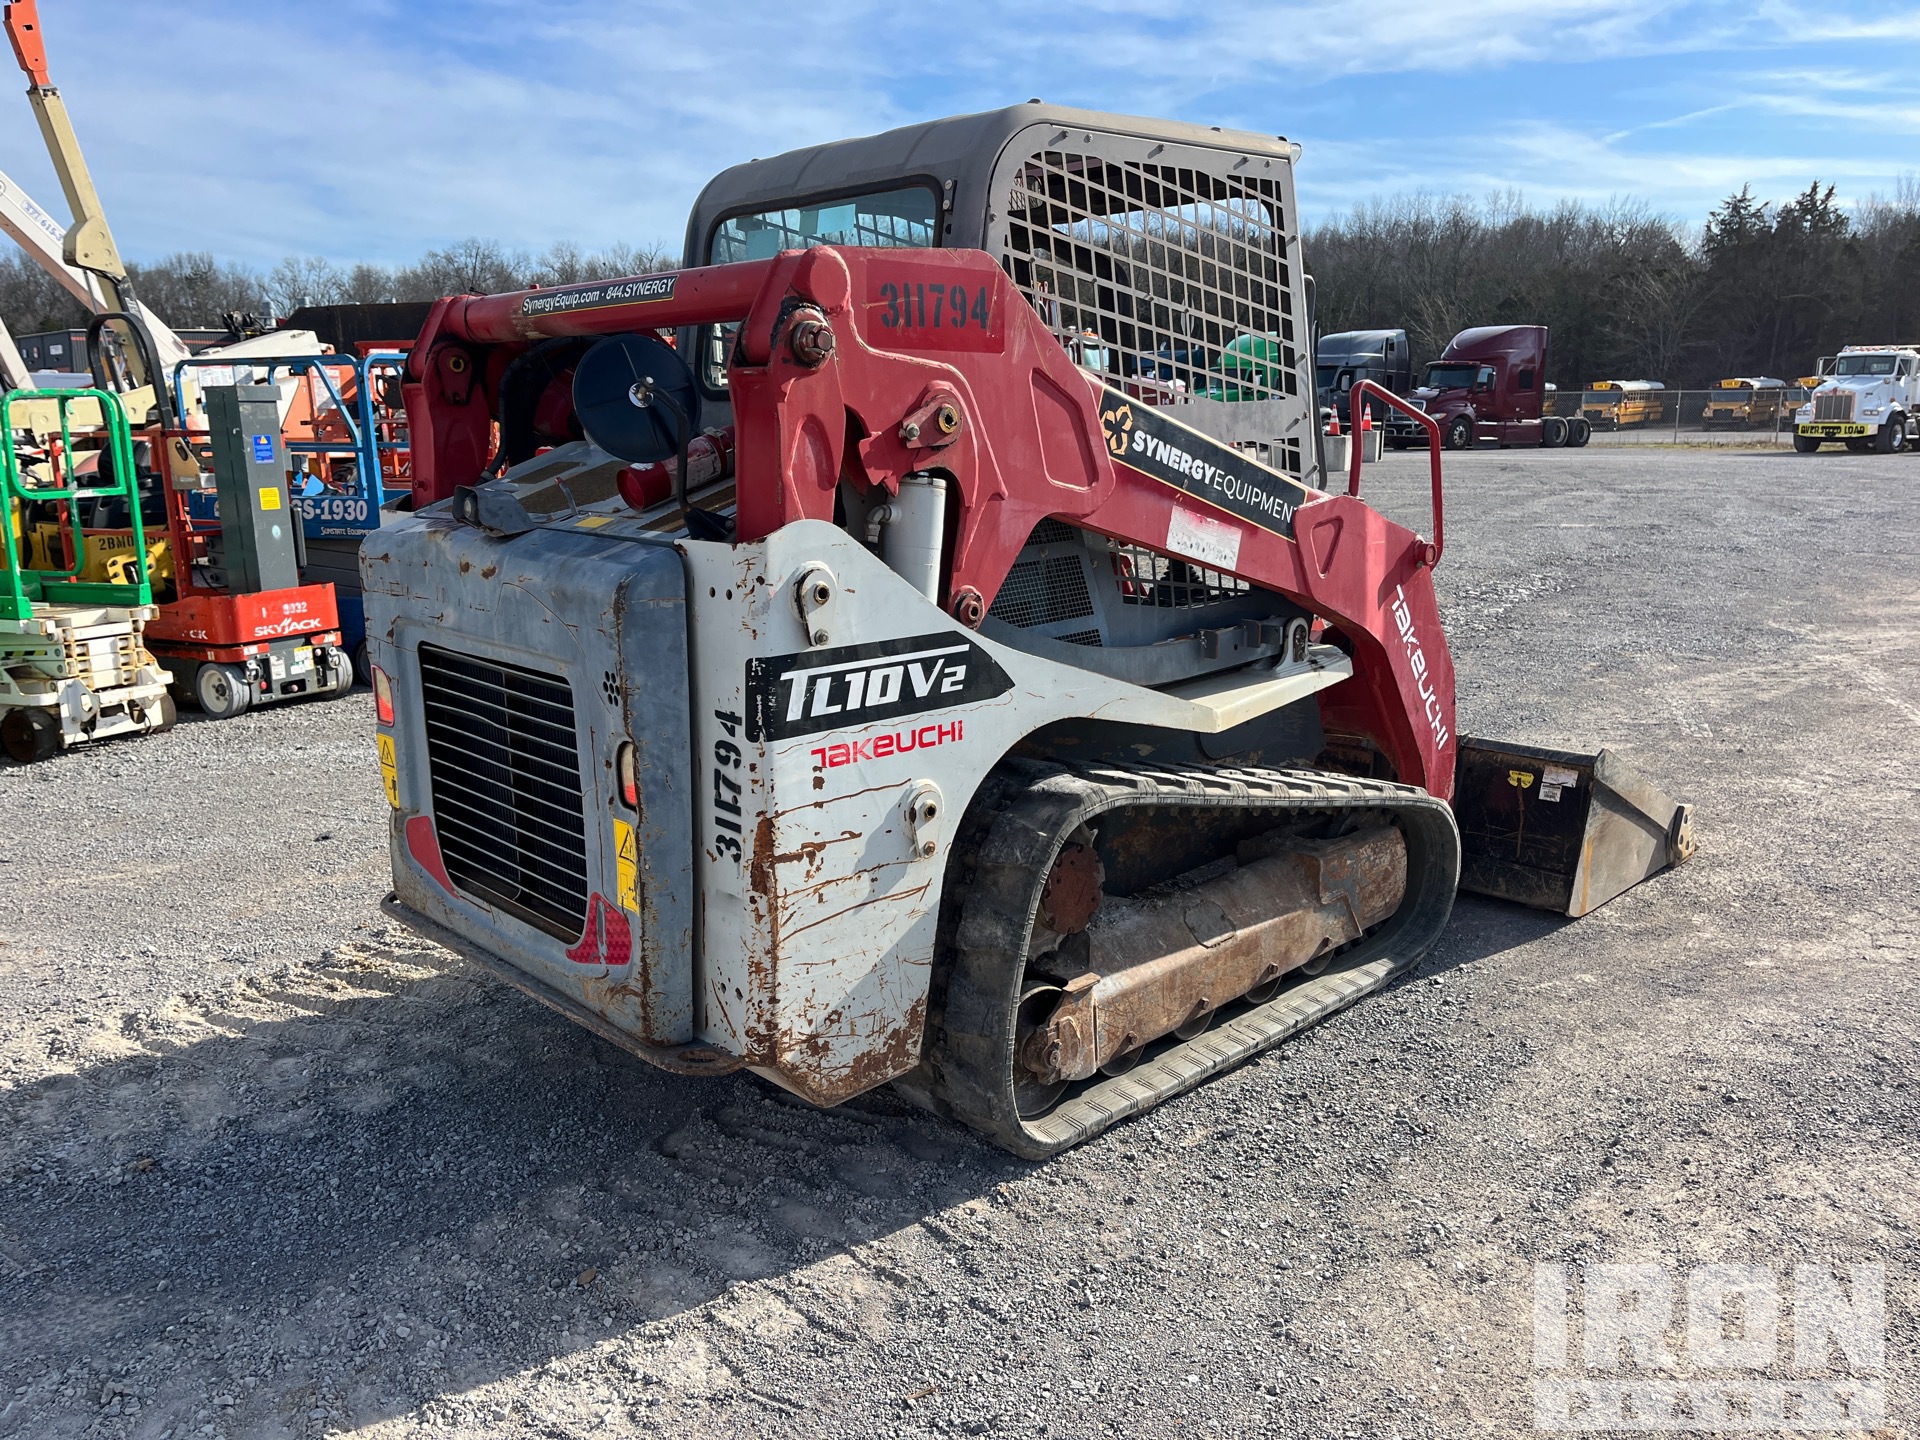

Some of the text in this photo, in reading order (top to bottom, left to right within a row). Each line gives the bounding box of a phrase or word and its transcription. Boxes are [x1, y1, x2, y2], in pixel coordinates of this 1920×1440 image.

[522, 277, 676, 314] SynergyEquip.com 844.SYNERGY
[880, 281, 989, 330] 311794
[1131, 429, 1299, 525] SYNERGYEQUIPMEN
[254, 617, 322, 637] SKYJACK
[780, 644, 970, 722] TL10V2
[714, 709, 743, 863] 311794
